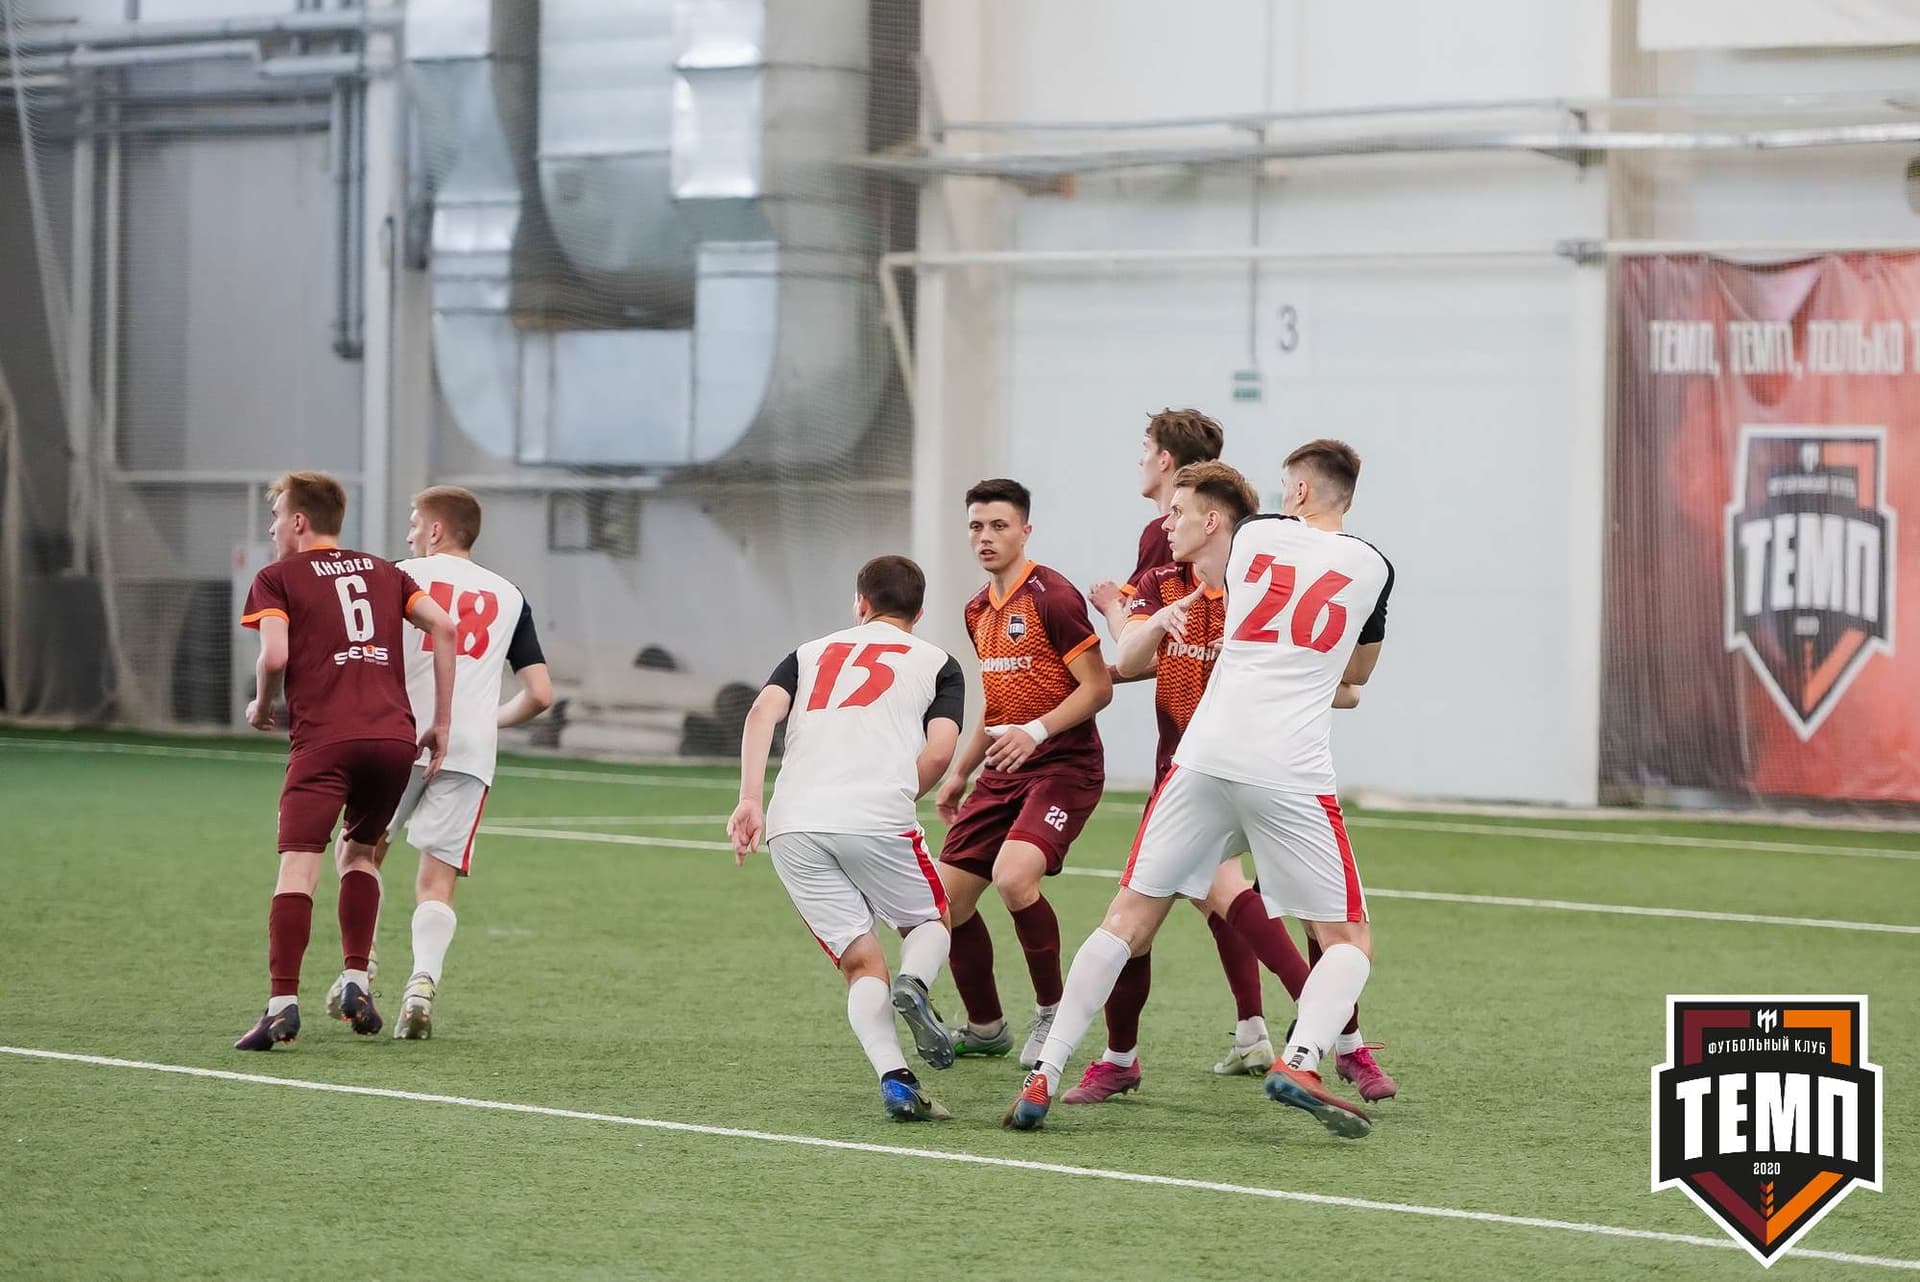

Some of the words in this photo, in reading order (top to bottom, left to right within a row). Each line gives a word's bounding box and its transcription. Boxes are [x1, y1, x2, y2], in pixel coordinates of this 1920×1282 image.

[1279, 304, 1299, 352] 3
[1650, 320, 1720, 378] ТЕМП,
[1728, 321, 1802, 380] ТЕМП,
[1808, 319, 1905, 374] ТОЛЬКО
[311, 558, 374, 576] КНЯЗЕВ
[1741, 513, 1880, 622] ТЕМП
[335, 574, 374, 642] 6
[1230, 553, 1354, 654] 26
[806, 642, 912, 711] 15
[1044, 805, 1068, 832] 22
